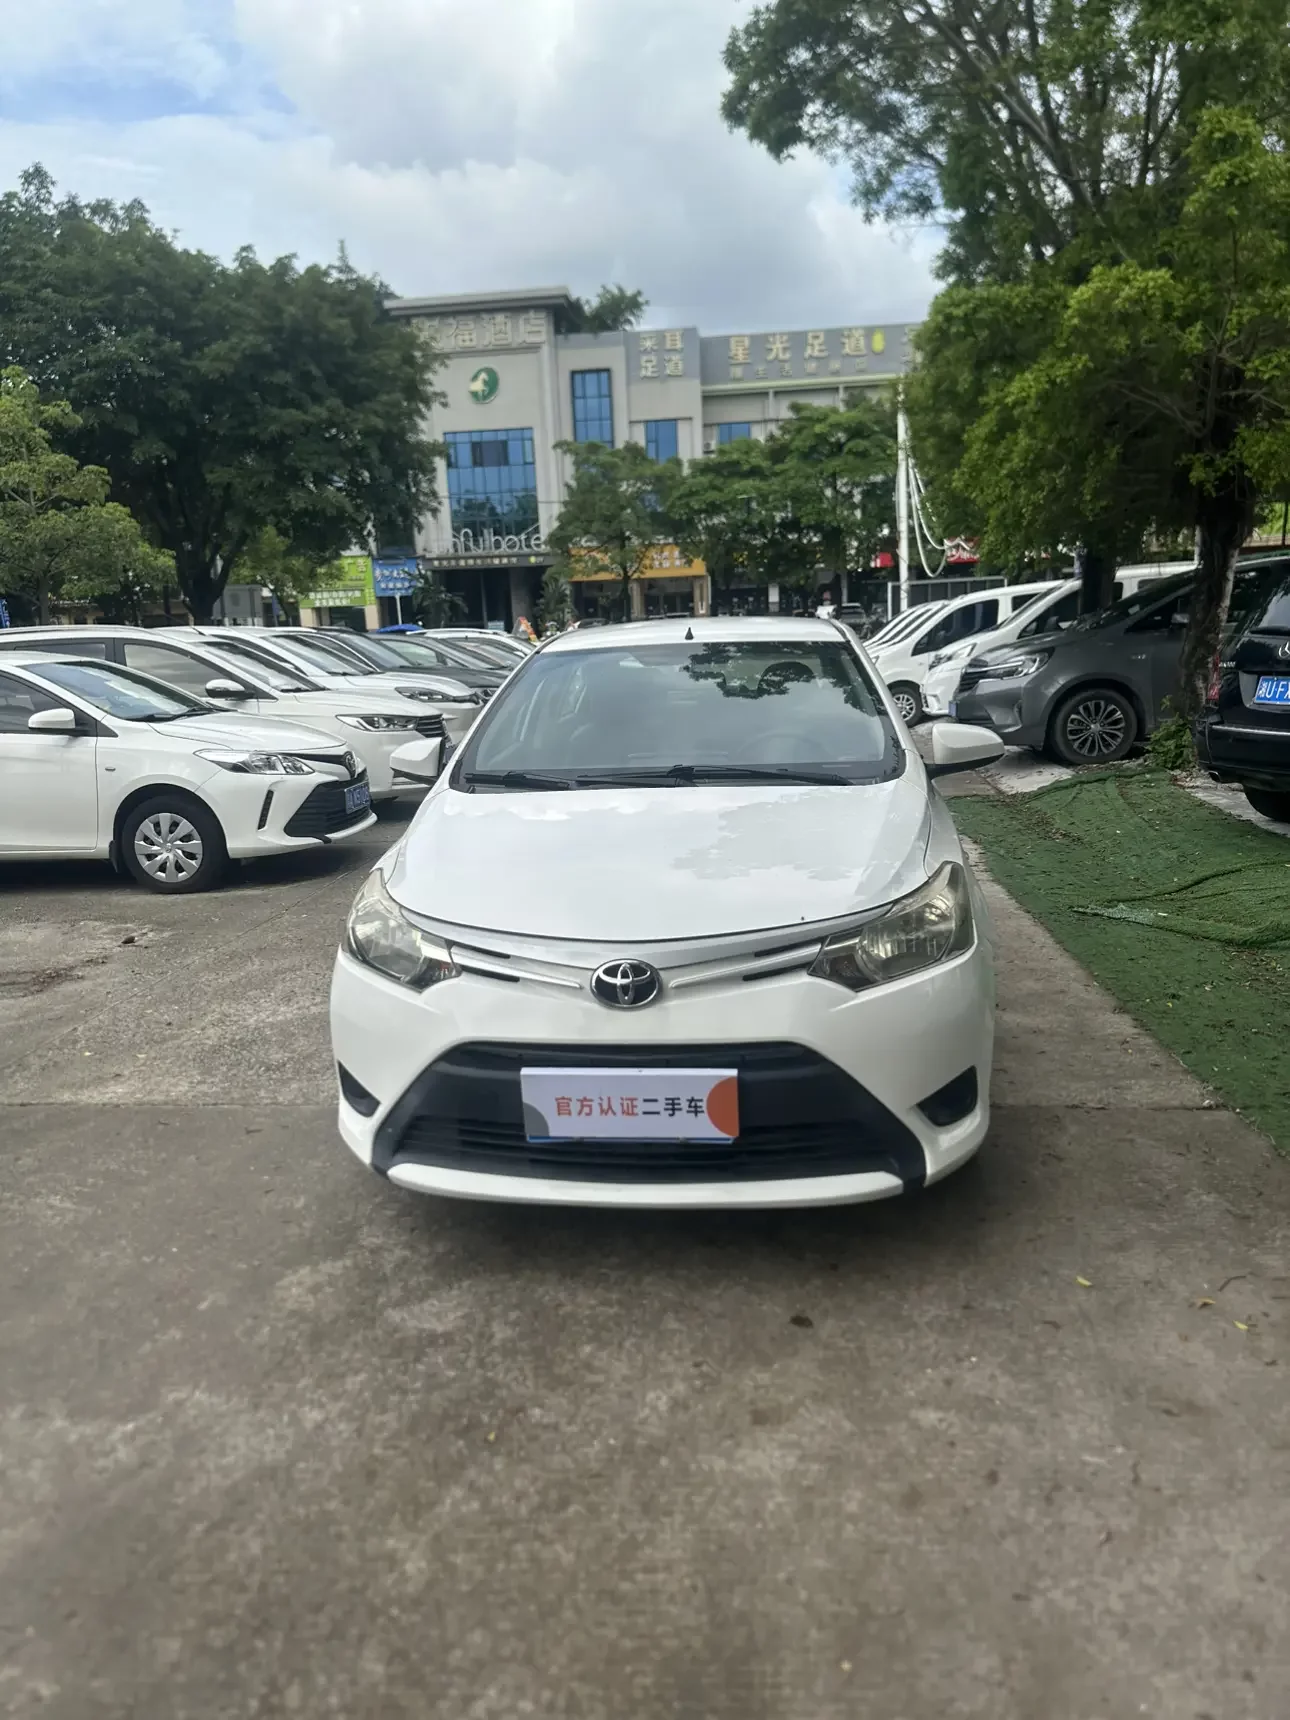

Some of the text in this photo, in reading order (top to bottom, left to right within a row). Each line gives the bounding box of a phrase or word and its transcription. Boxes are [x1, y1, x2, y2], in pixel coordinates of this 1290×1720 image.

[729, 328, 866, 364] 星光足道
[640, 355, 685, 378] 足道
[555, 1096, 705, 1118] 官方认证二手车
